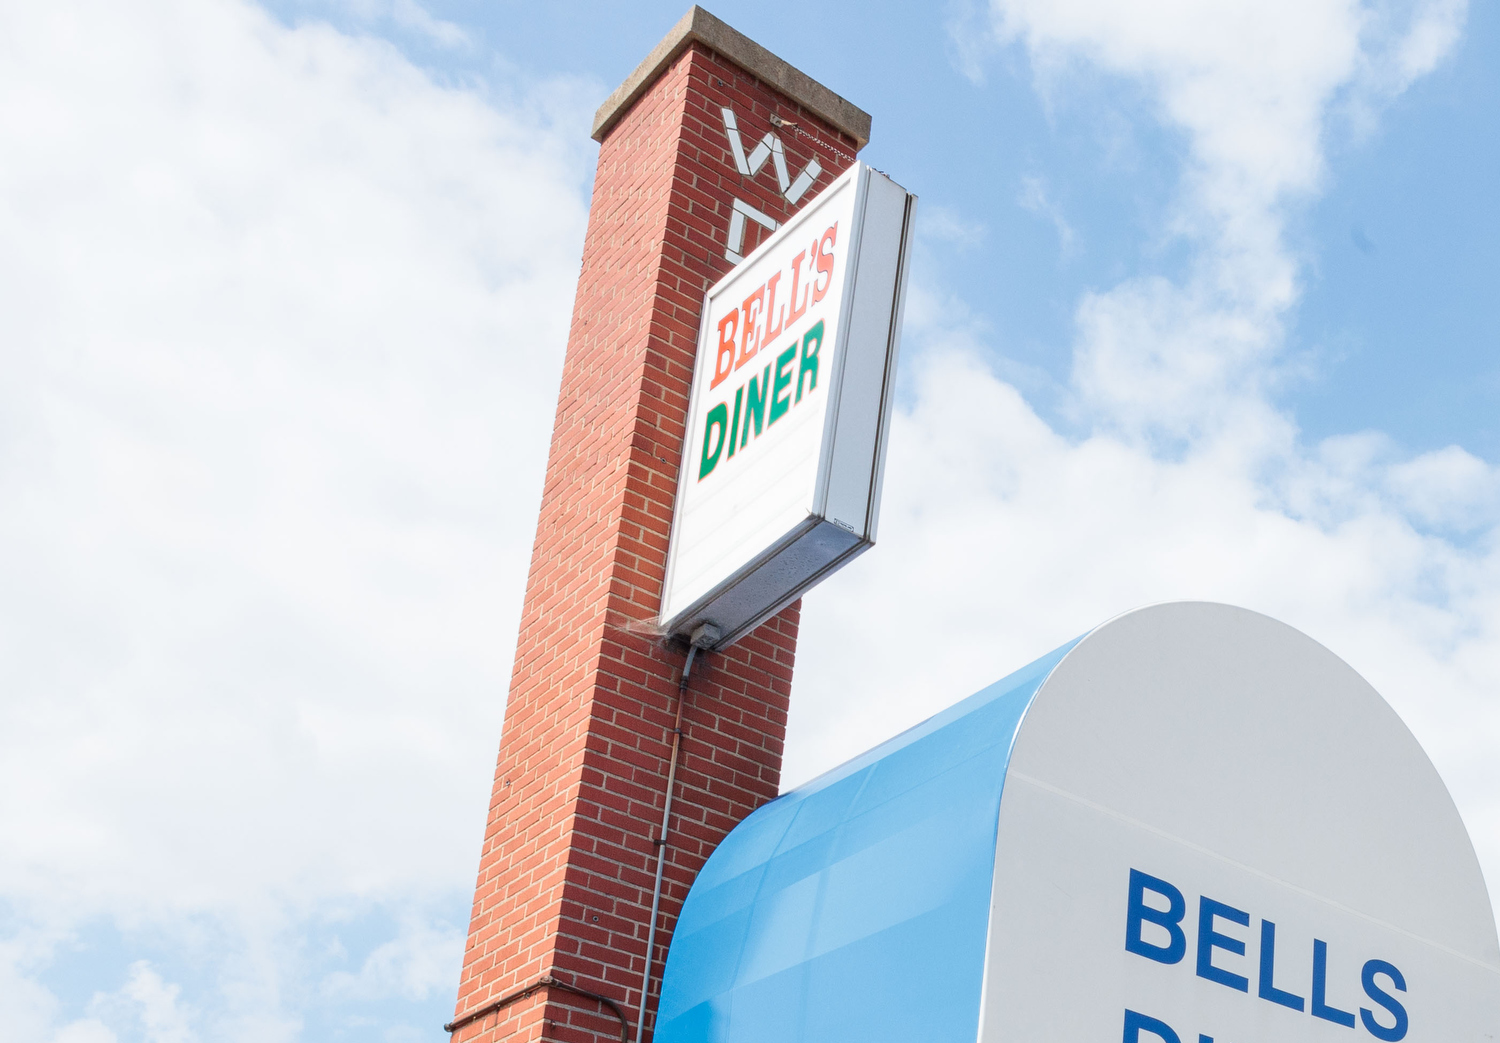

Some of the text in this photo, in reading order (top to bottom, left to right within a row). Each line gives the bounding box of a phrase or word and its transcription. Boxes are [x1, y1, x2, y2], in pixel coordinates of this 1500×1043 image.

[709, 220, 839, 392] BELL'S
[697, 317, 826, 484] DINER
[1124, 867, 1409, 1043] BELLS
